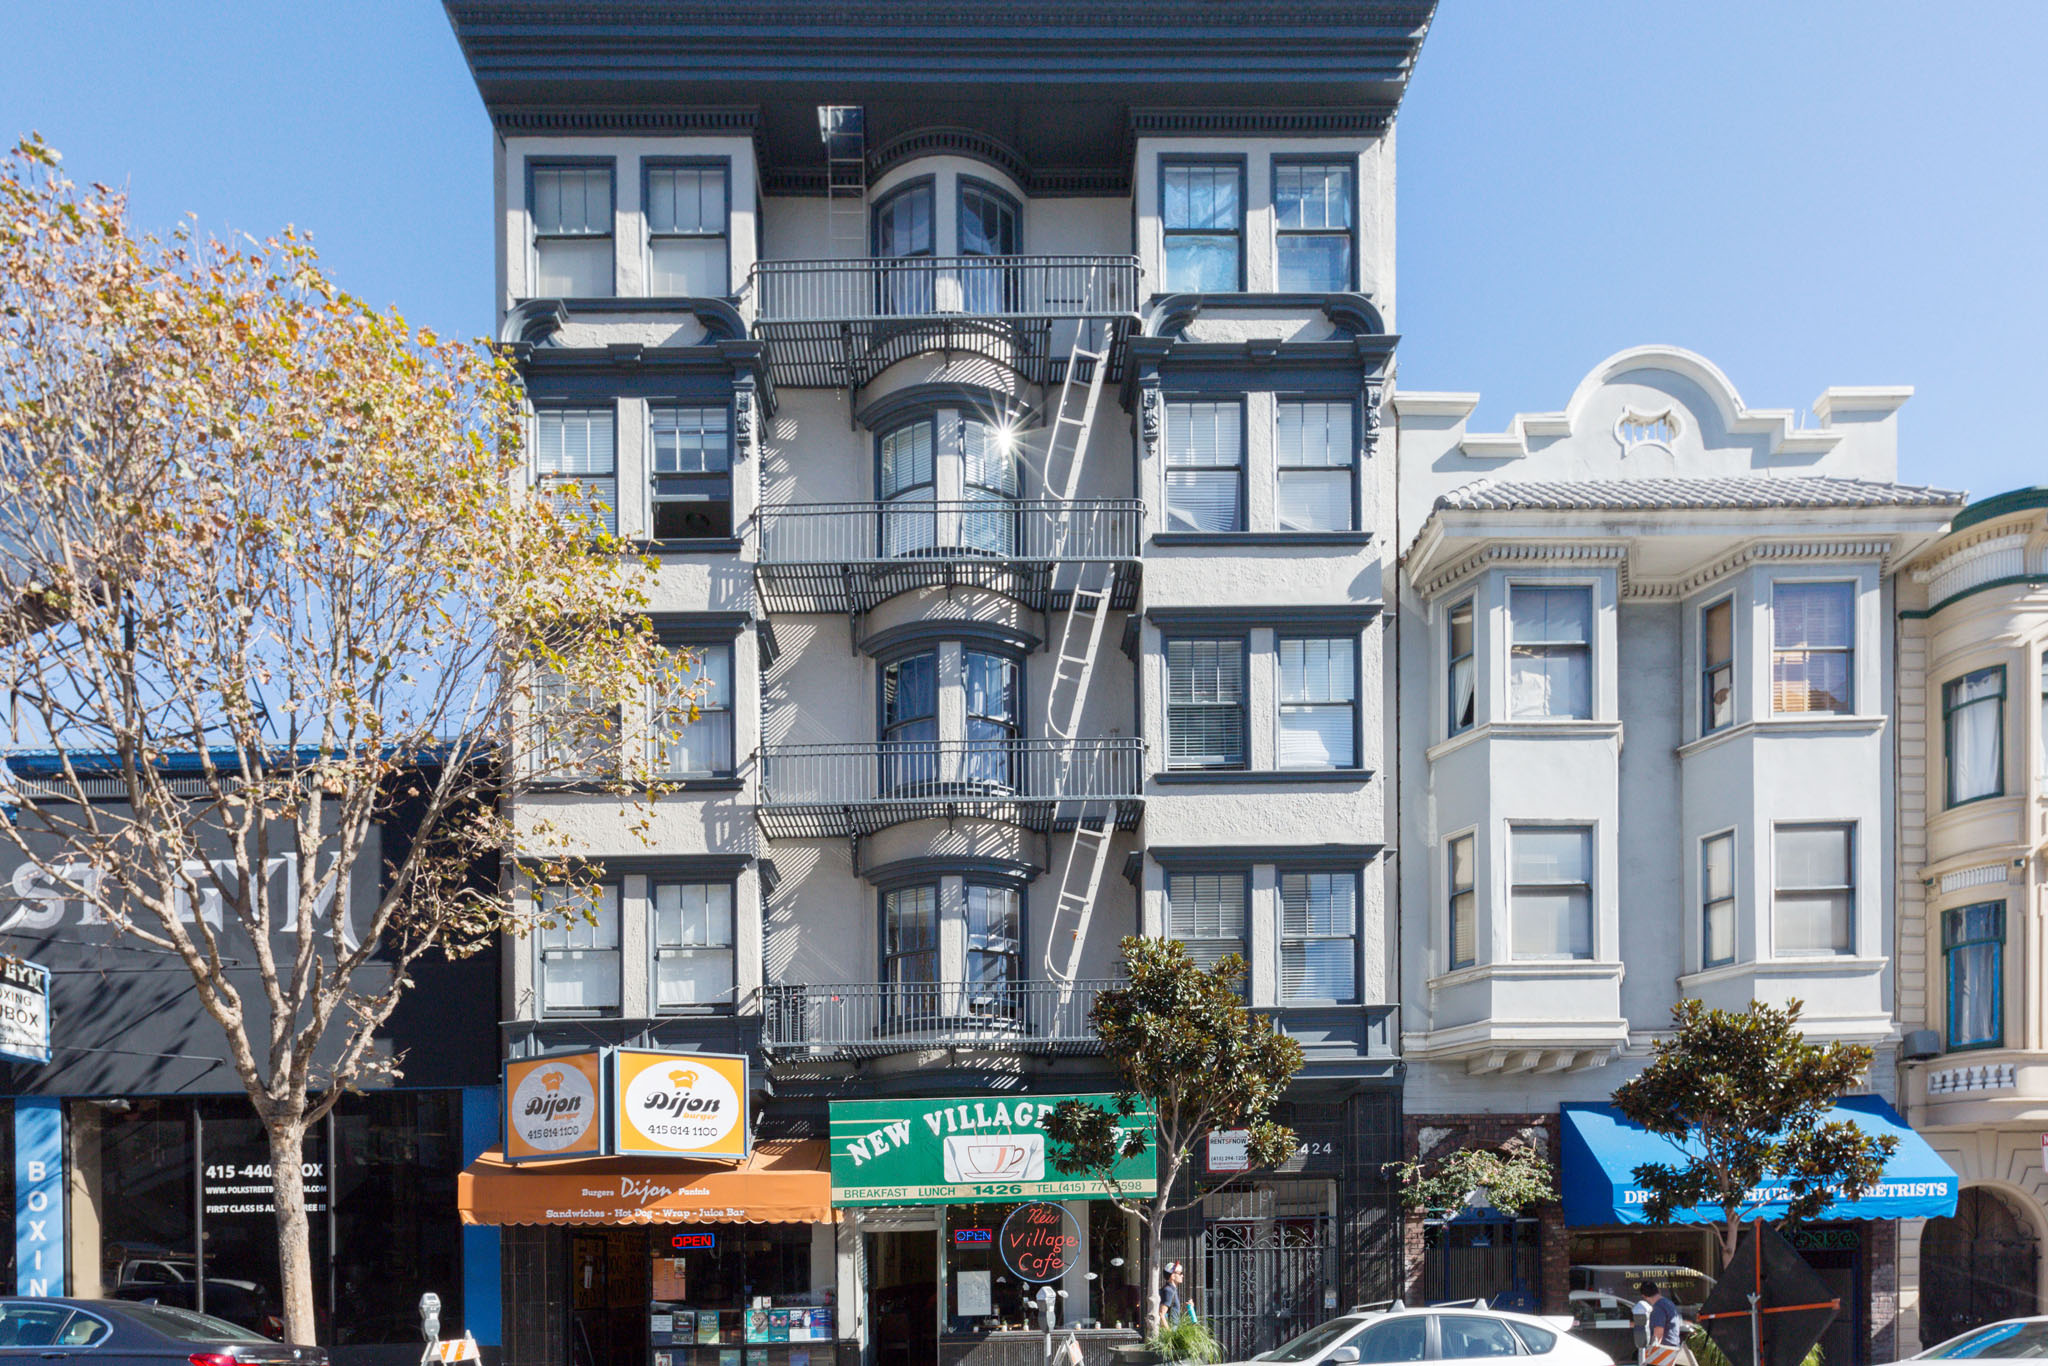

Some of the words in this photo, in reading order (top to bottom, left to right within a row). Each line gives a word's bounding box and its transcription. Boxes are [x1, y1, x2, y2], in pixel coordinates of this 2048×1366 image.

[5, 962, 44, 995] GYM
[0, 988, 32, 1007] XING
[525, 1093, 581, 1121] Dijon
[644, 1091, 720, 1118] Dijon
[683, 1112, 718, 1121] burger
[528, 1130, 542, 1139] 415
[560, 1126, 579, 1136] 1100
[648, 1125, 668, 1135] 415
[670, 1126, 690, 1135] 614
[693, 1127, 717, 1137] 1100
[846, 1119, 911, 1166] NEW
[1300, 1143, 1332, 1155] 424
[205, 1165, 235, 1178] 415
[581, 1188, 615, 1198] Burgers
[620, 1176, 673, 1204] Dijon
[678, 1187, 710, 1196] Paninis
[843, 1188, 908, 1199] BREAKFAST
[918, 1186, 956, 1198] LUNCH
[972, 1184, 1023, 1196] 1426
[206, 1205, 229, 1213] FIRST
[230, 1204, 255, 1213] CLASS
[256, 1204, 264, 1212] IS
[546, 1209, 605, 1219] Sandwiches
[614, 1209, 632, 1218] Hot
[634, 1208, 653, 1220] Dog
[663, 1209, 690, 1219] Wrap
[699, 1209, 724, 1217] Juice
[727, 1208, 745, 1217] Bar
[1026, 1208, 1060, 1225] New
[28, 1160, 48, 1297] BOXIN
[956, 1231, 991, 1241] OPEN
[672, 1236, 712, 1248] OPEN
[1010, 1228, 1079, 1254] Village
[1018, 1252, 1065, 1278] Cafe
